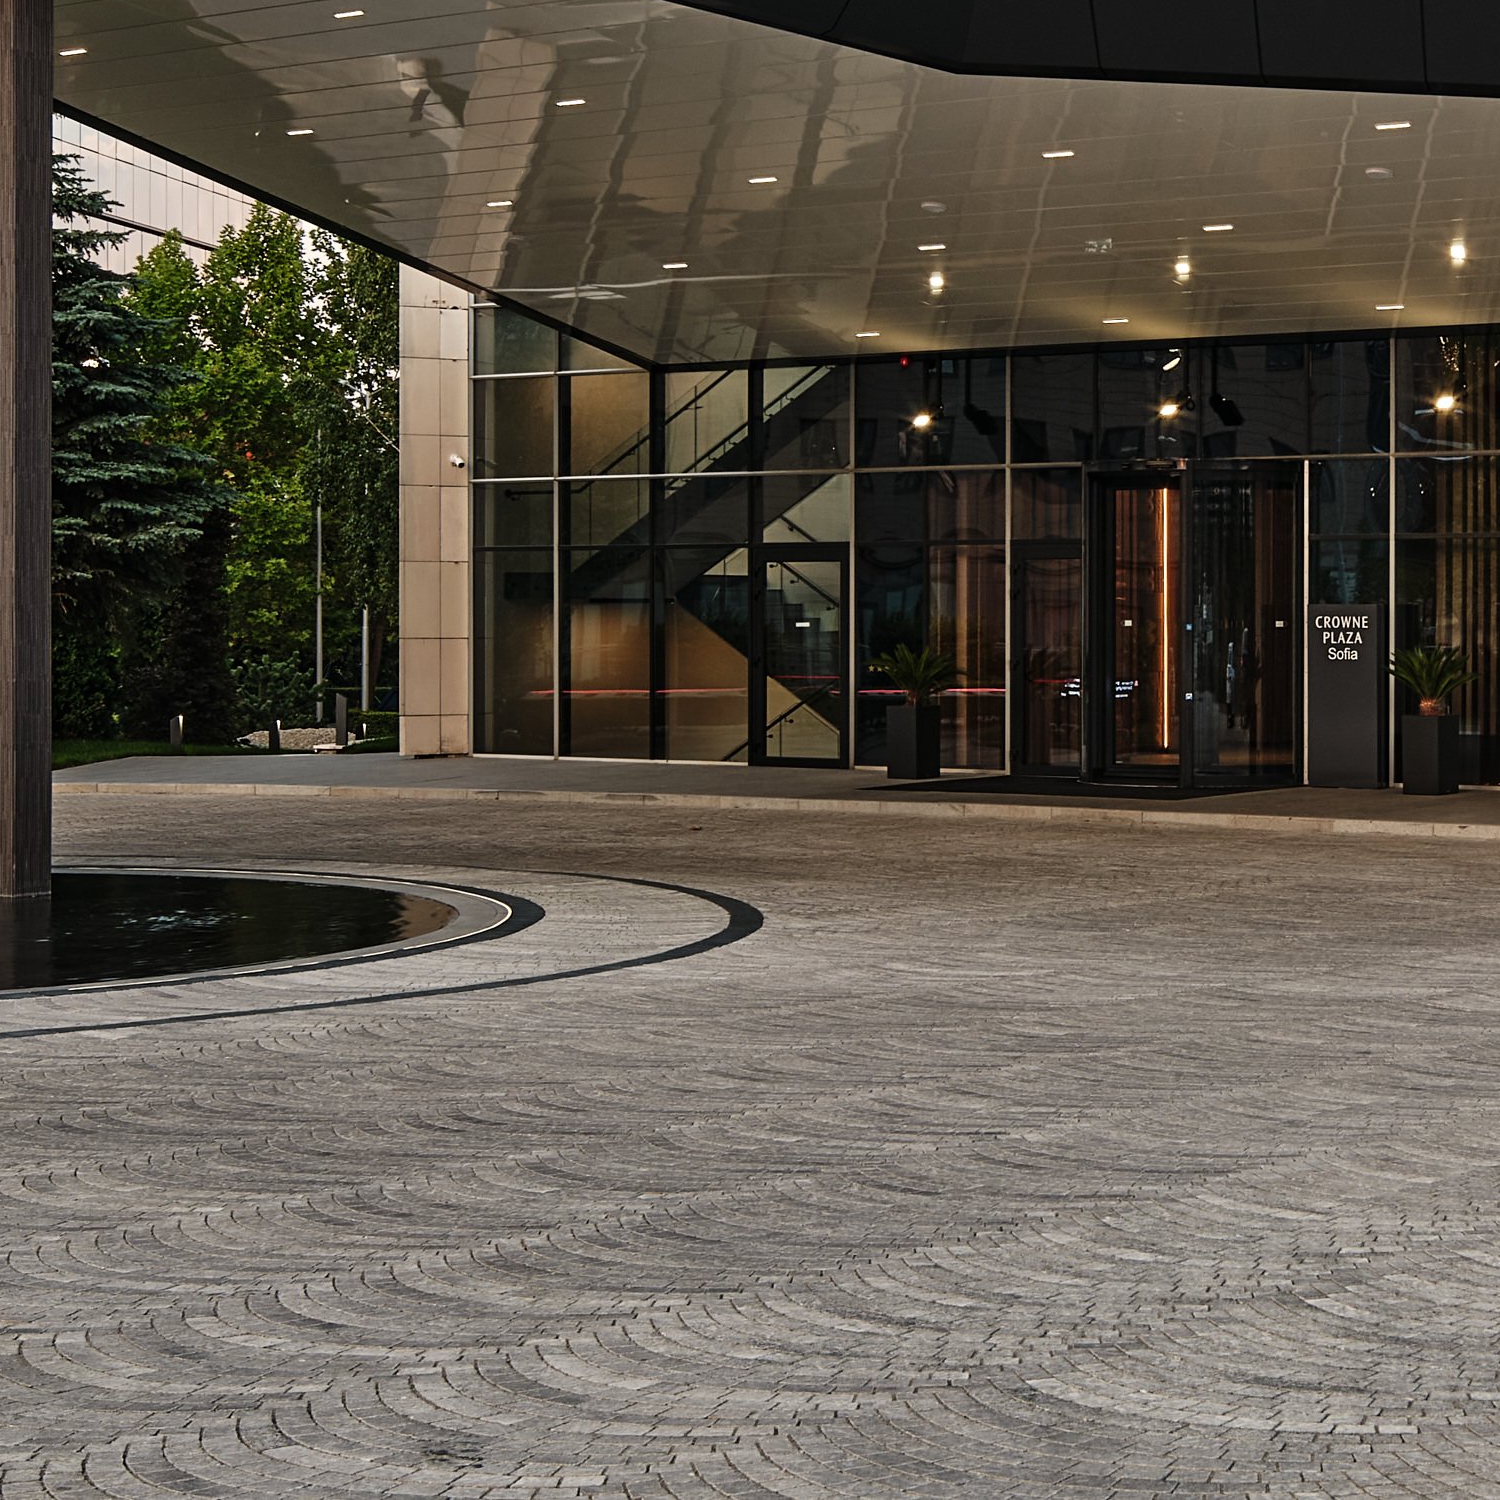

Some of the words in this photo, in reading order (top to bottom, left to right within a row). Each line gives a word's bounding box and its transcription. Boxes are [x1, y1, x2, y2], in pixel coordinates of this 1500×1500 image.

[1315, 615, 1369, 629] CROWNE
[1322, 631, 1363, 644] PLAZA
[1327, 647, 1359, 660] Sofia
